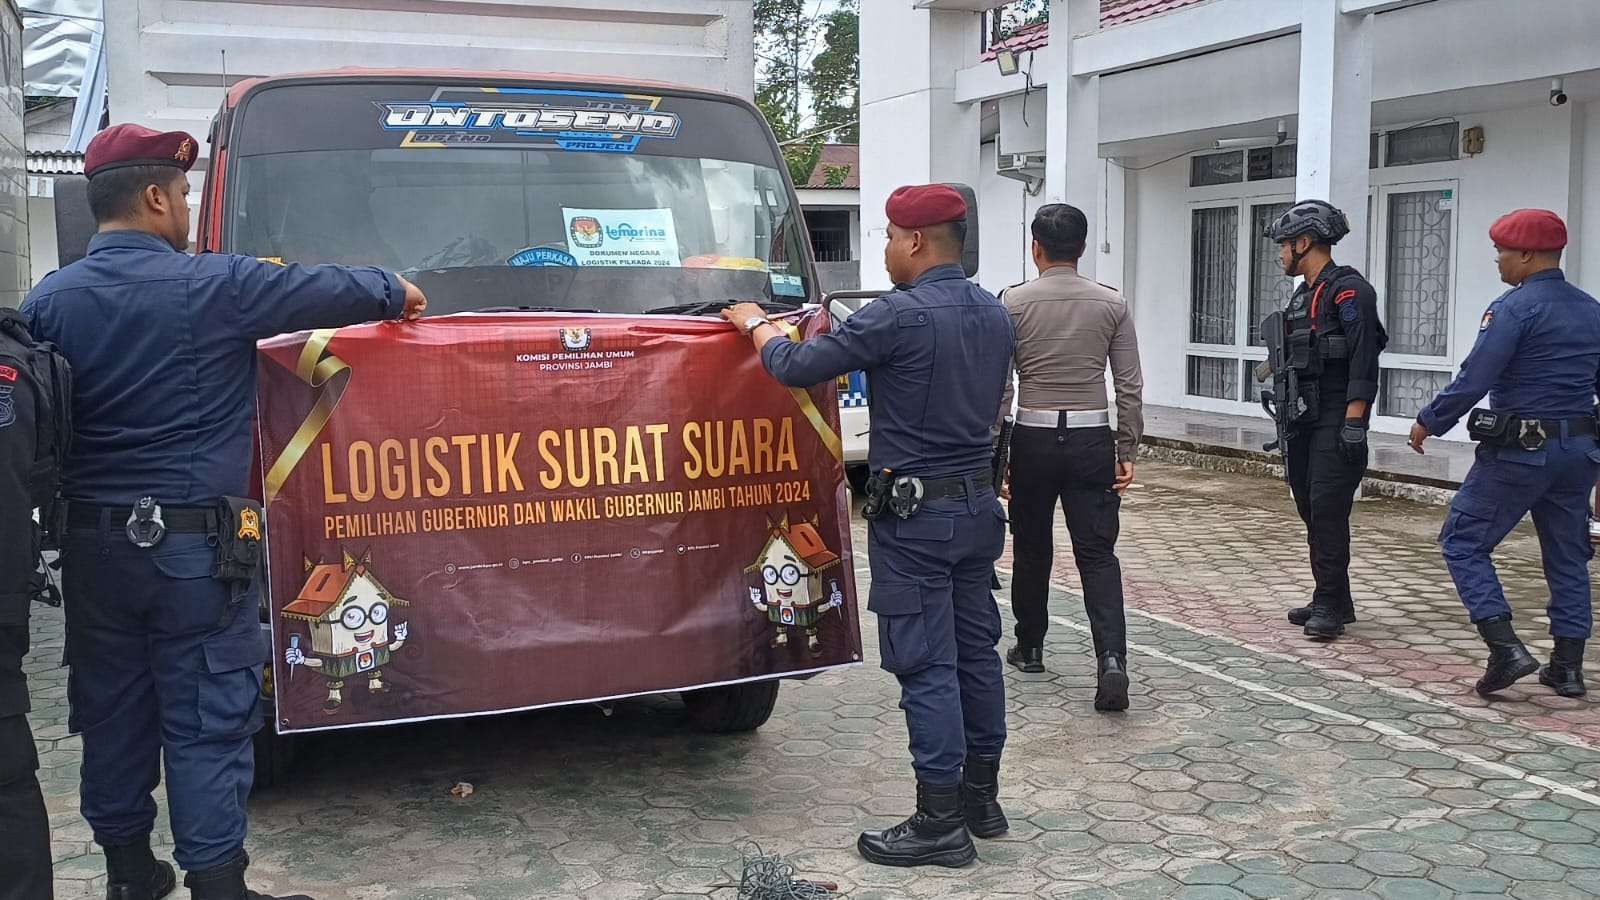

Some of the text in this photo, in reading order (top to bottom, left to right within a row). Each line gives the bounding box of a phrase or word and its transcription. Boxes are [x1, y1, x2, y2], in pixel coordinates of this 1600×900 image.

[564, 141, 634, 150] PROJECT
[512, 251, 574, 266] MAJU PERKASA
[516, 350, 635, 362] KOMISI PEMILIHAN UMUM
[539, 361, 613, 371] PROVINSI JAMBI
[321, 416, 799, 504] LOGISTIK SURAT SUARA
[324, 480, 811, 540] PEMILIHAN GUBERNUR DAN WAKIL GUBERNUR JAMBI TAHUN 2024
